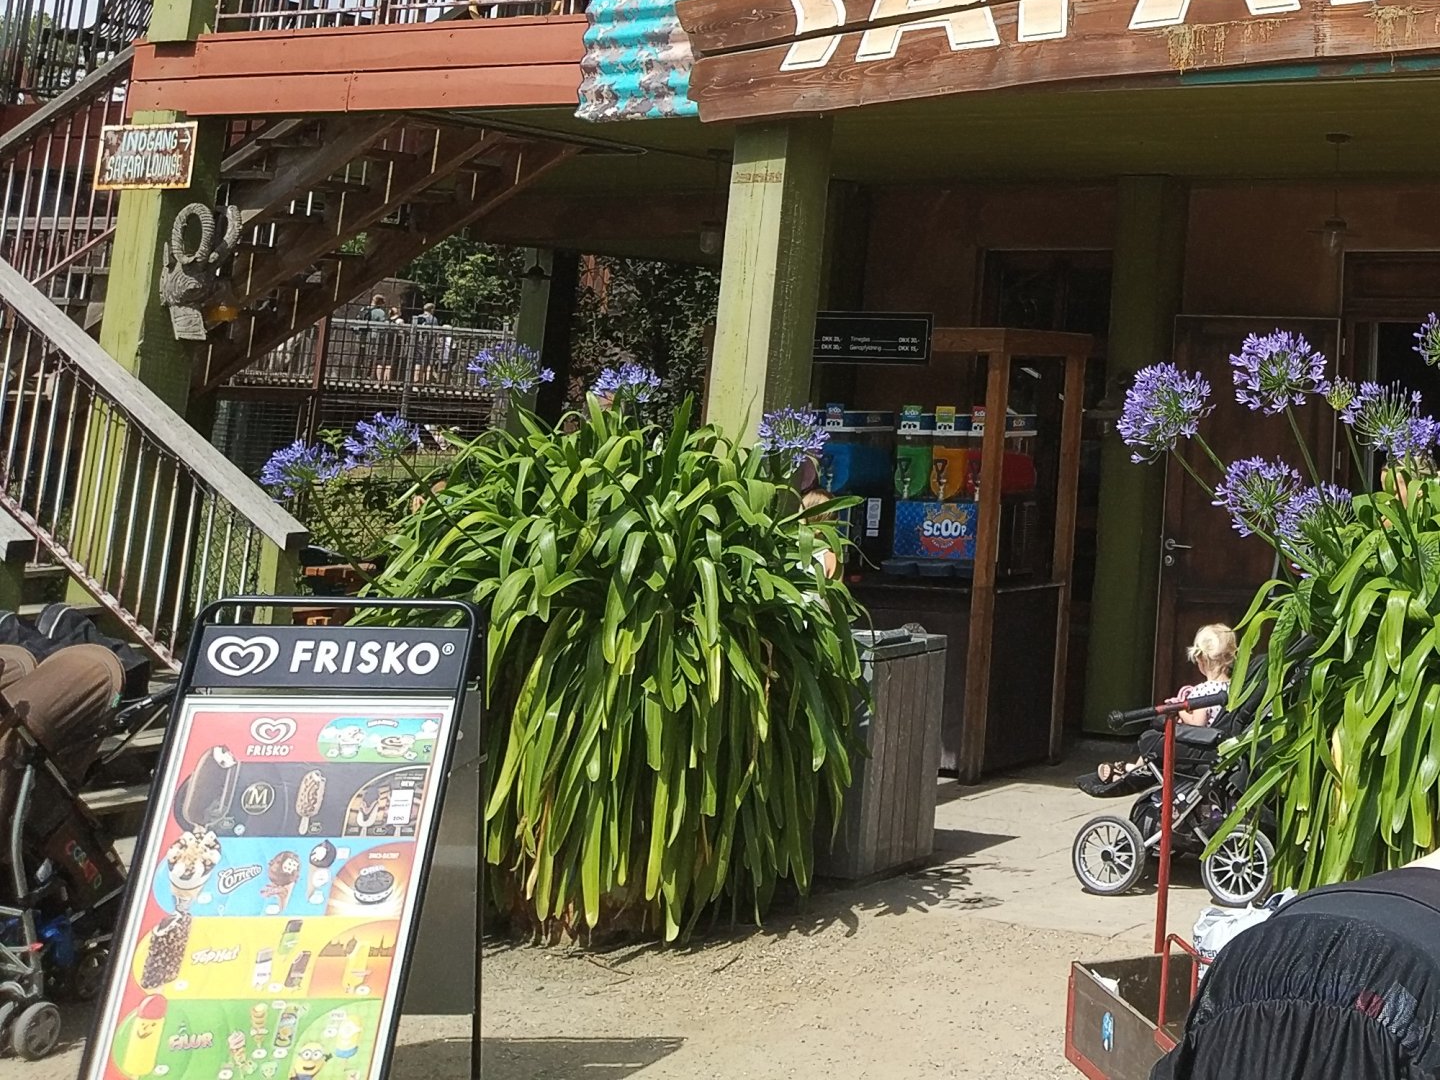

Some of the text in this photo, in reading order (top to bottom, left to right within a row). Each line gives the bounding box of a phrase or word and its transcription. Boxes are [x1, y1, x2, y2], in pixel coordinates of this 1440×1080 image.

[121, 129, 178, 152] INDGANG
[106, 153, 183, 181] SAFARI LOUNGE
[289, 640, 441, 675] FRISKO
[246, 744, 290, 757] FRISKO
